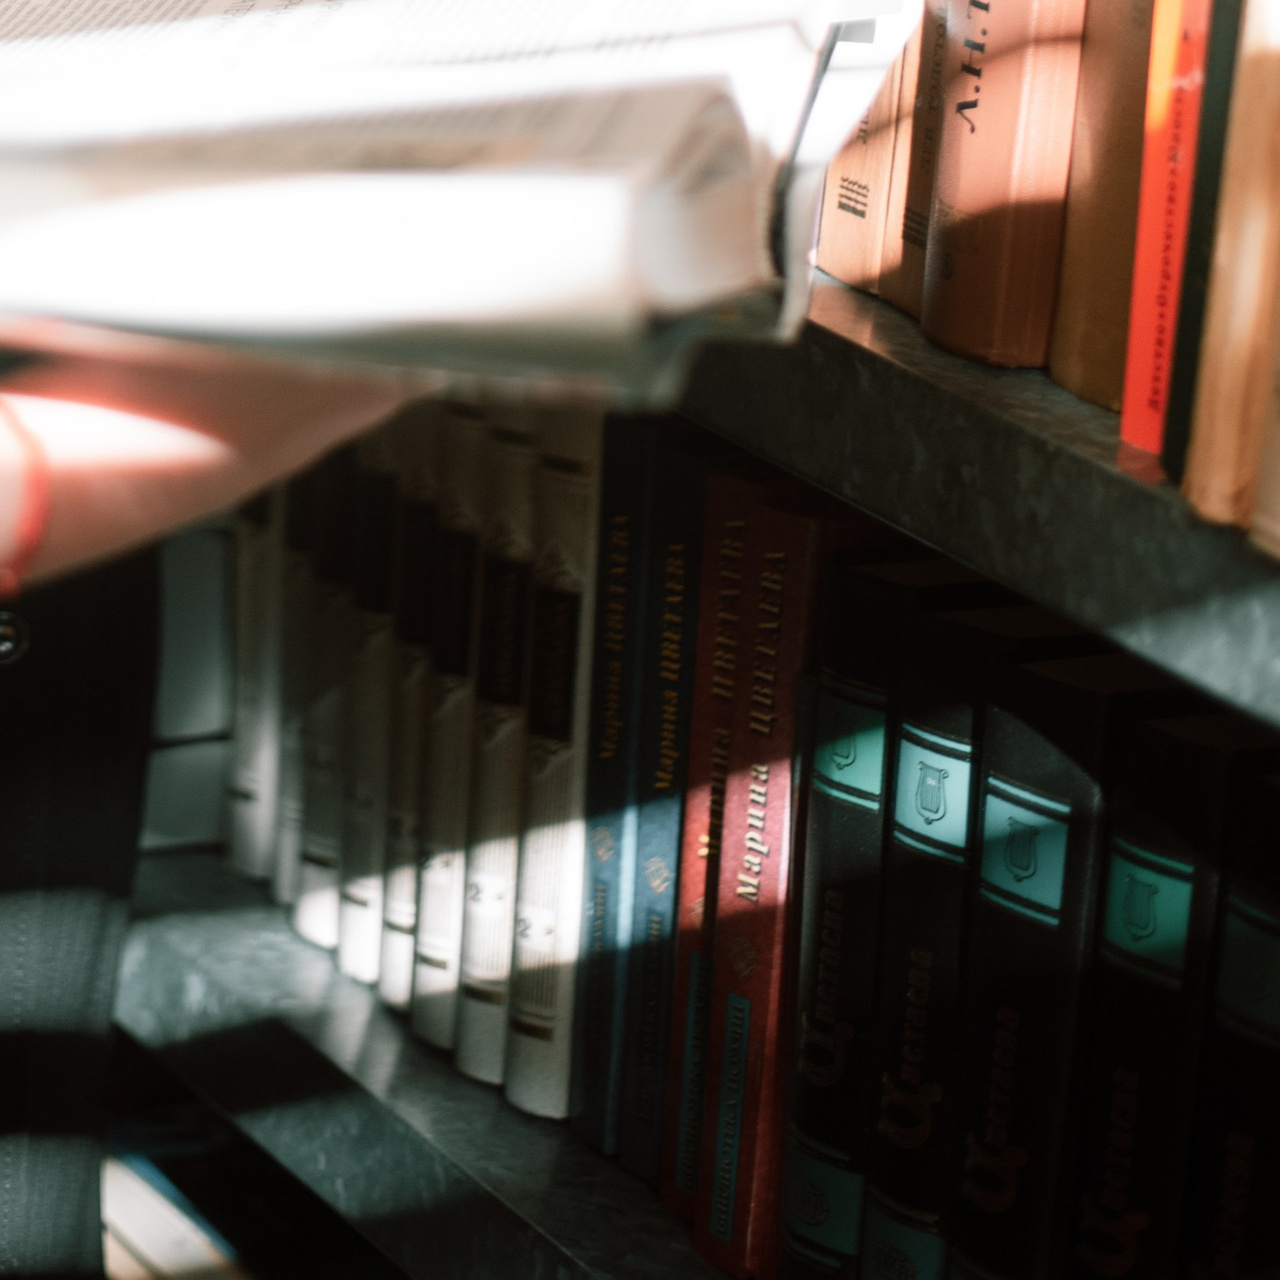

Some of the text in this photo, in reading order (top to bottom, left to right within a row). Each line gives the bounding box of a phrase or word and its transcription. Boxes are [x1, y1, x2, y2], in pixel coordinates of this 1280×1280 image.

[654, 543, 686, 791] Марина ЦВЕТАЕВА
[735, 550, 786, 904] Марина ЦВЕТАЕВА
